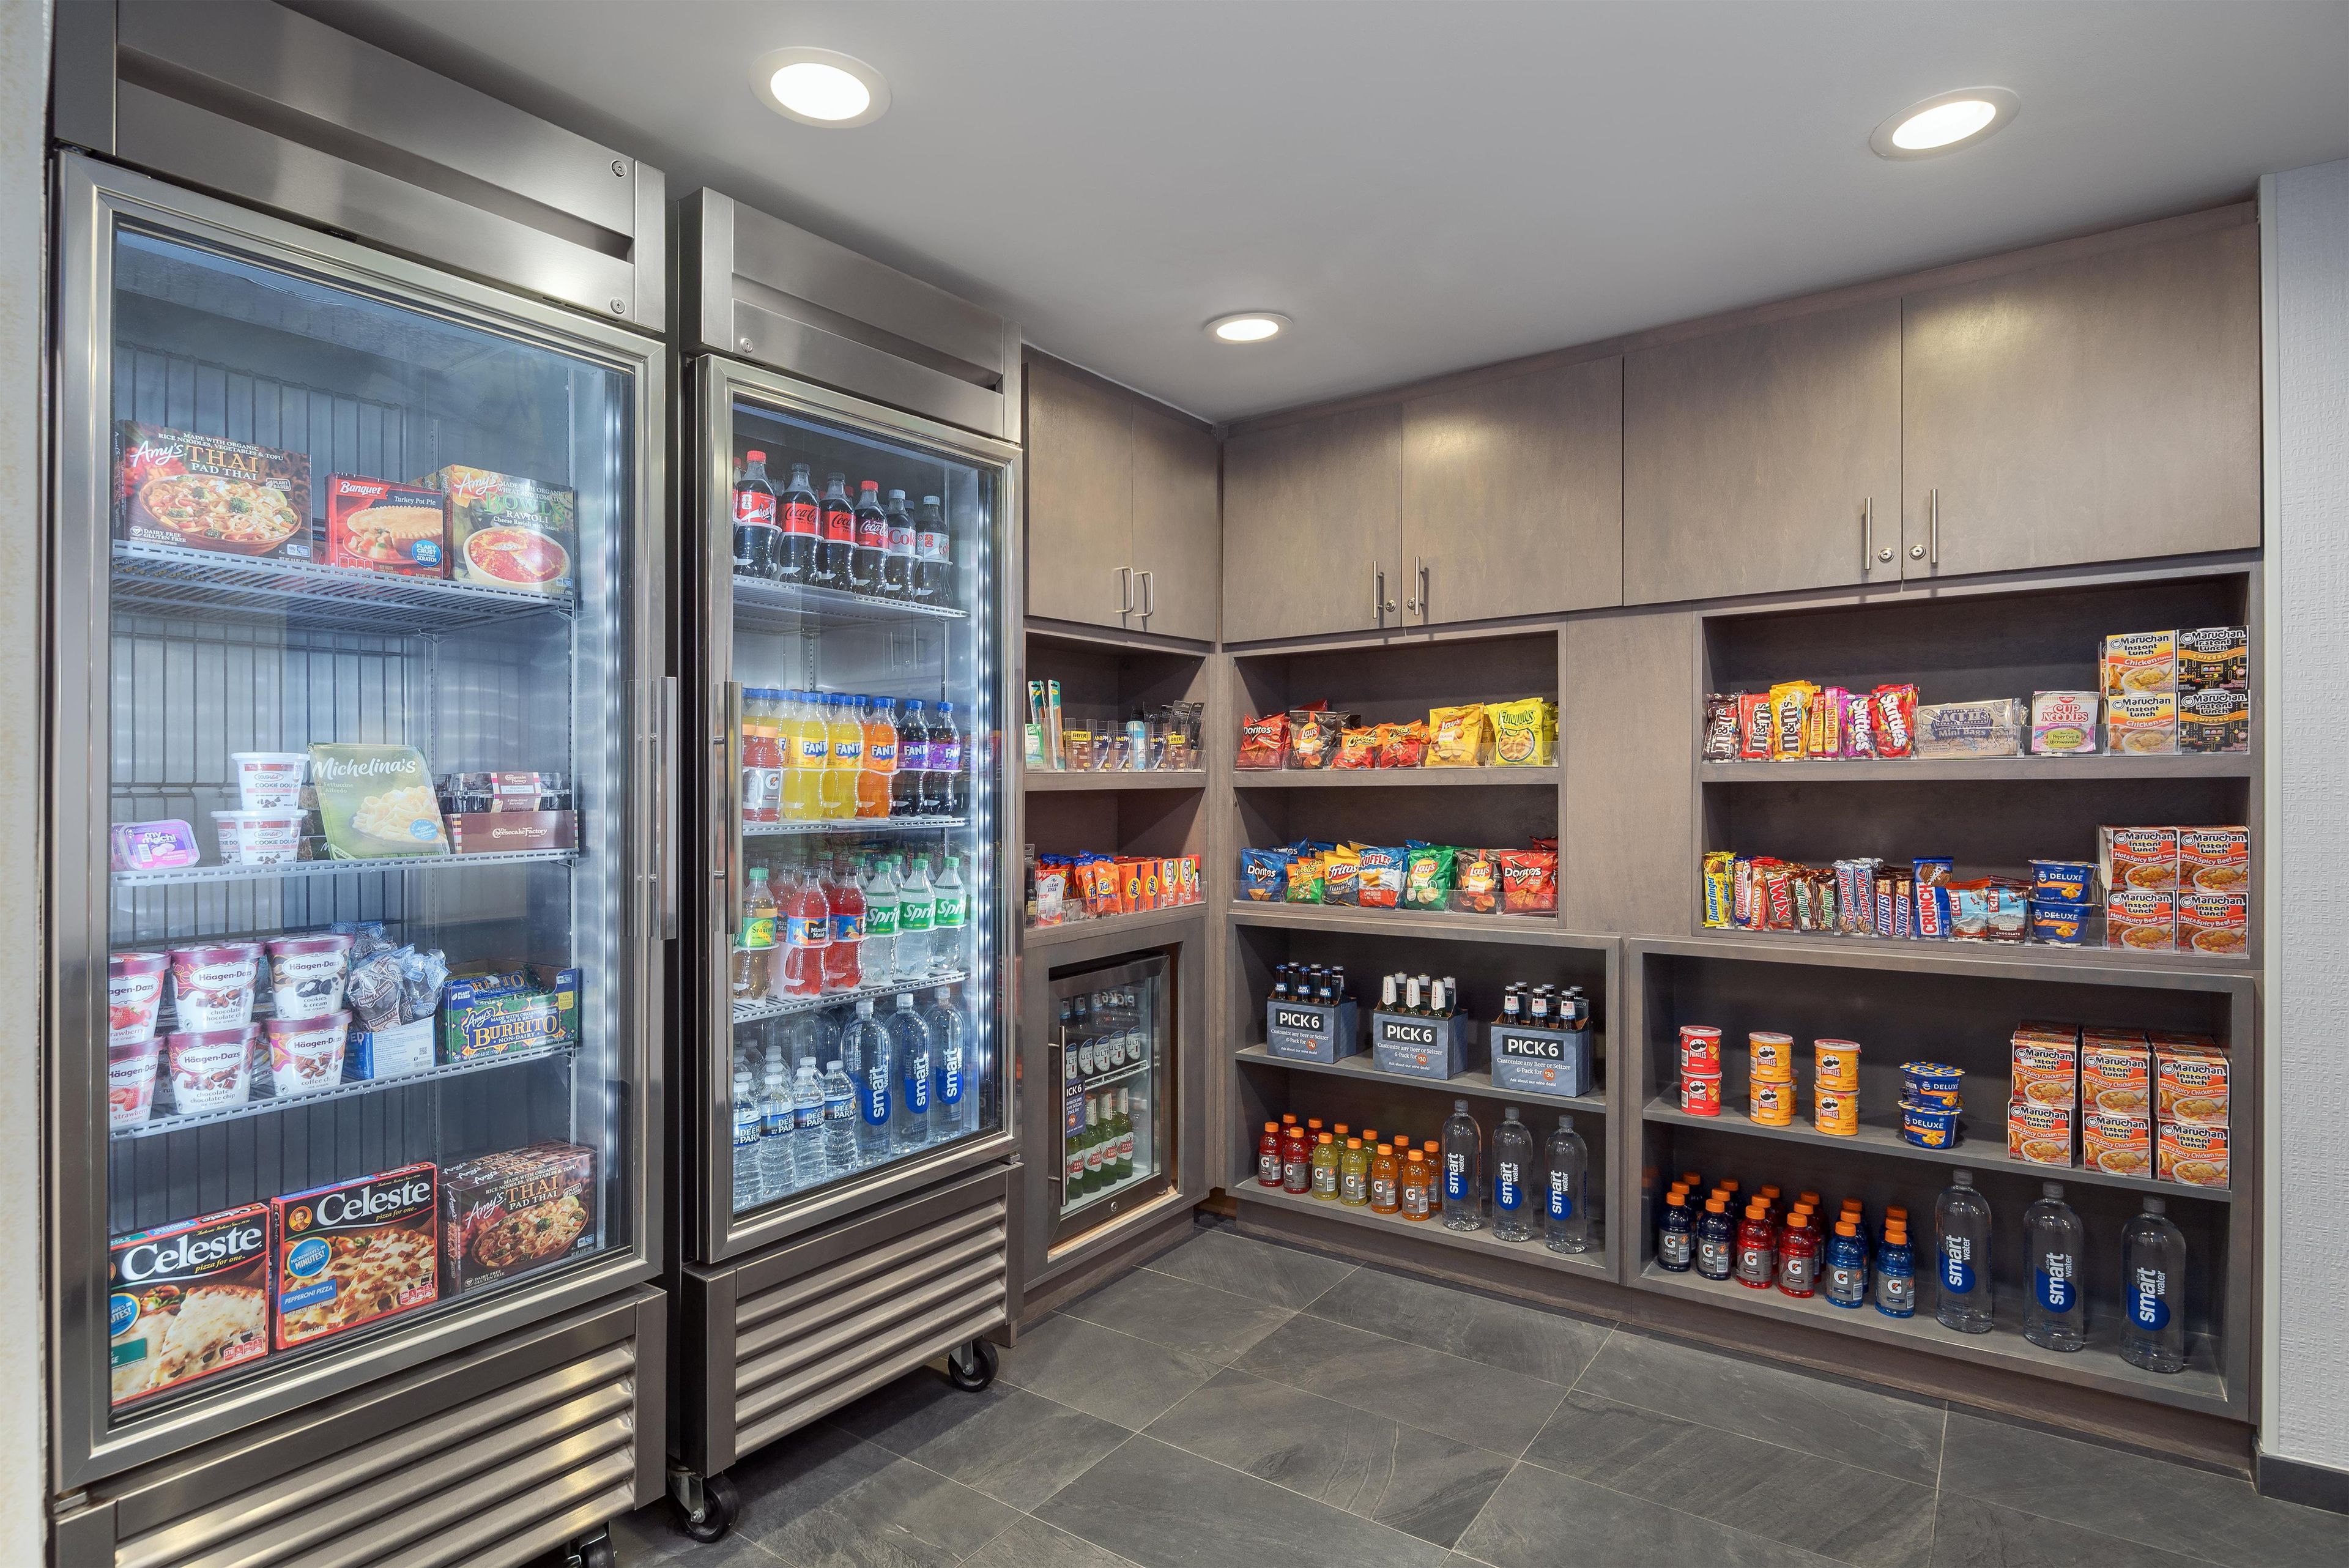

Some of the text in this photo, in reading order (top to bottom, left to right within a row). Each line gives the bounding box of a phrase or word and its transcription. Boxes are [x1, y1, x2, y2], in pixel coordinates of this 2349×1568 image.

[177, 436, 213, 448] NOODLES,
[215, 444, 256, 456] VEGETABLES
[184, 433, 259, 451] MADE WITH ORGANIC
[130, 440, 184, 467] Amy's
[186, 445, 259, 472] THAI
[191, 463, 257, 480] PAD THAI
[340, 481, 383, 496] Banquet
[455, 472, 499, 497] Amy's
[394, 496, 414, 505] Turkey
[484, 492, 566, 524] BOWLS
[507, 510, 548, 523] RAVIOLI
[514, 519, 531, 527] Ravioli
[2121, 635, 2169, 644] Maruchan
[2053, 704, 2080, 713] CUP
[1499, 710, 1534, 725] FUNYUNS
[1852, 700, 1868, 752] Skittles
[1879, 694, 1906, 748] Skittles
[2042, 712, 2088, 723] NOODLES
[1244, 726, 1271, 734] Doritos
[1301, 726, 1318, 739] Lay's
[1827, 708, 1836, 746] Starburst
[312, 757, 416, 779] Michelina's
[524, 827, 547, 836] Factory
[2126, 833, 2174, 841] Maruchan
[1359, 855, 1391, 868] RUFFLES
[1414, 864, 1436, 874] Lay's
[1248, 864, 1277, 877] Doritos
[1329, 864, 1357, 879] Fritos
[1470, 865, 1490, 877] Lay's
[1504, 868, 1541, 877] Doritos
[1099, 882, 1110, 891] Tide
[1709, 876, 1720, 921] Butterfinger
[1857, 875, 1872, 923] Musketeers
[1896, 896, 1908, 936] SNICKERS
[1921, 883, 1937, 934] CRUNCH
[465, 1009, 492, 1033] Amy's
[1280, 1012, 1319, 1028] PICK 6
[473, 1015, 557, 1047] BURRITO
[499, 1032, 535, 1043] NON-DAIRY
[1387, 1025, 1432, 1042] PICK 6
[1508, 1039, 1559, 1057] PICK 6
[1690, 1050, 1707, 1059] PRINGLES
[1758, 1058, 1776, 1067] PRINGLES
[2173, 1064, 2225, 1074] Maruchan
[945, 1048, 957, 1097] smart
[1822, 1067, 1840, 1077] PRINGLES
[914, 1057, 926, 1106] smart
[869, 1065, 884, 1118] smart
[1912, 1119, 1943, 1129] DELUXE
[740, 1134, 760, 1143] PARK
[535, 1165, 558, 1176] ORGANIC
[1448, 1153, 1458, 1194] smart
[505, 1175, 558, 1203] THAI
[1501, 1162, 1512, 1204] smart
[317, 1181, 430, 1225] Celeste
[510, 1192, 557, 1210] PAD THAI
[376, 1213, 393, 1222] pizza
[393, 1209, 402, 1217] for
[465, 1192, 504, 1228] Amy's
[122, 1227, 262, 1281] Celeste
[291, 1248, 319, 1264] MICROWAVES
[294, 1251, 325, 1270] MINUTES!
[194, 1262, 215, 1273] pizza
[217, 1258, 227, 1268] for
[285, 1285, 333, 1304] PEPPERONI PIZZA
[2139, 1268, 2156, 1322] smart
